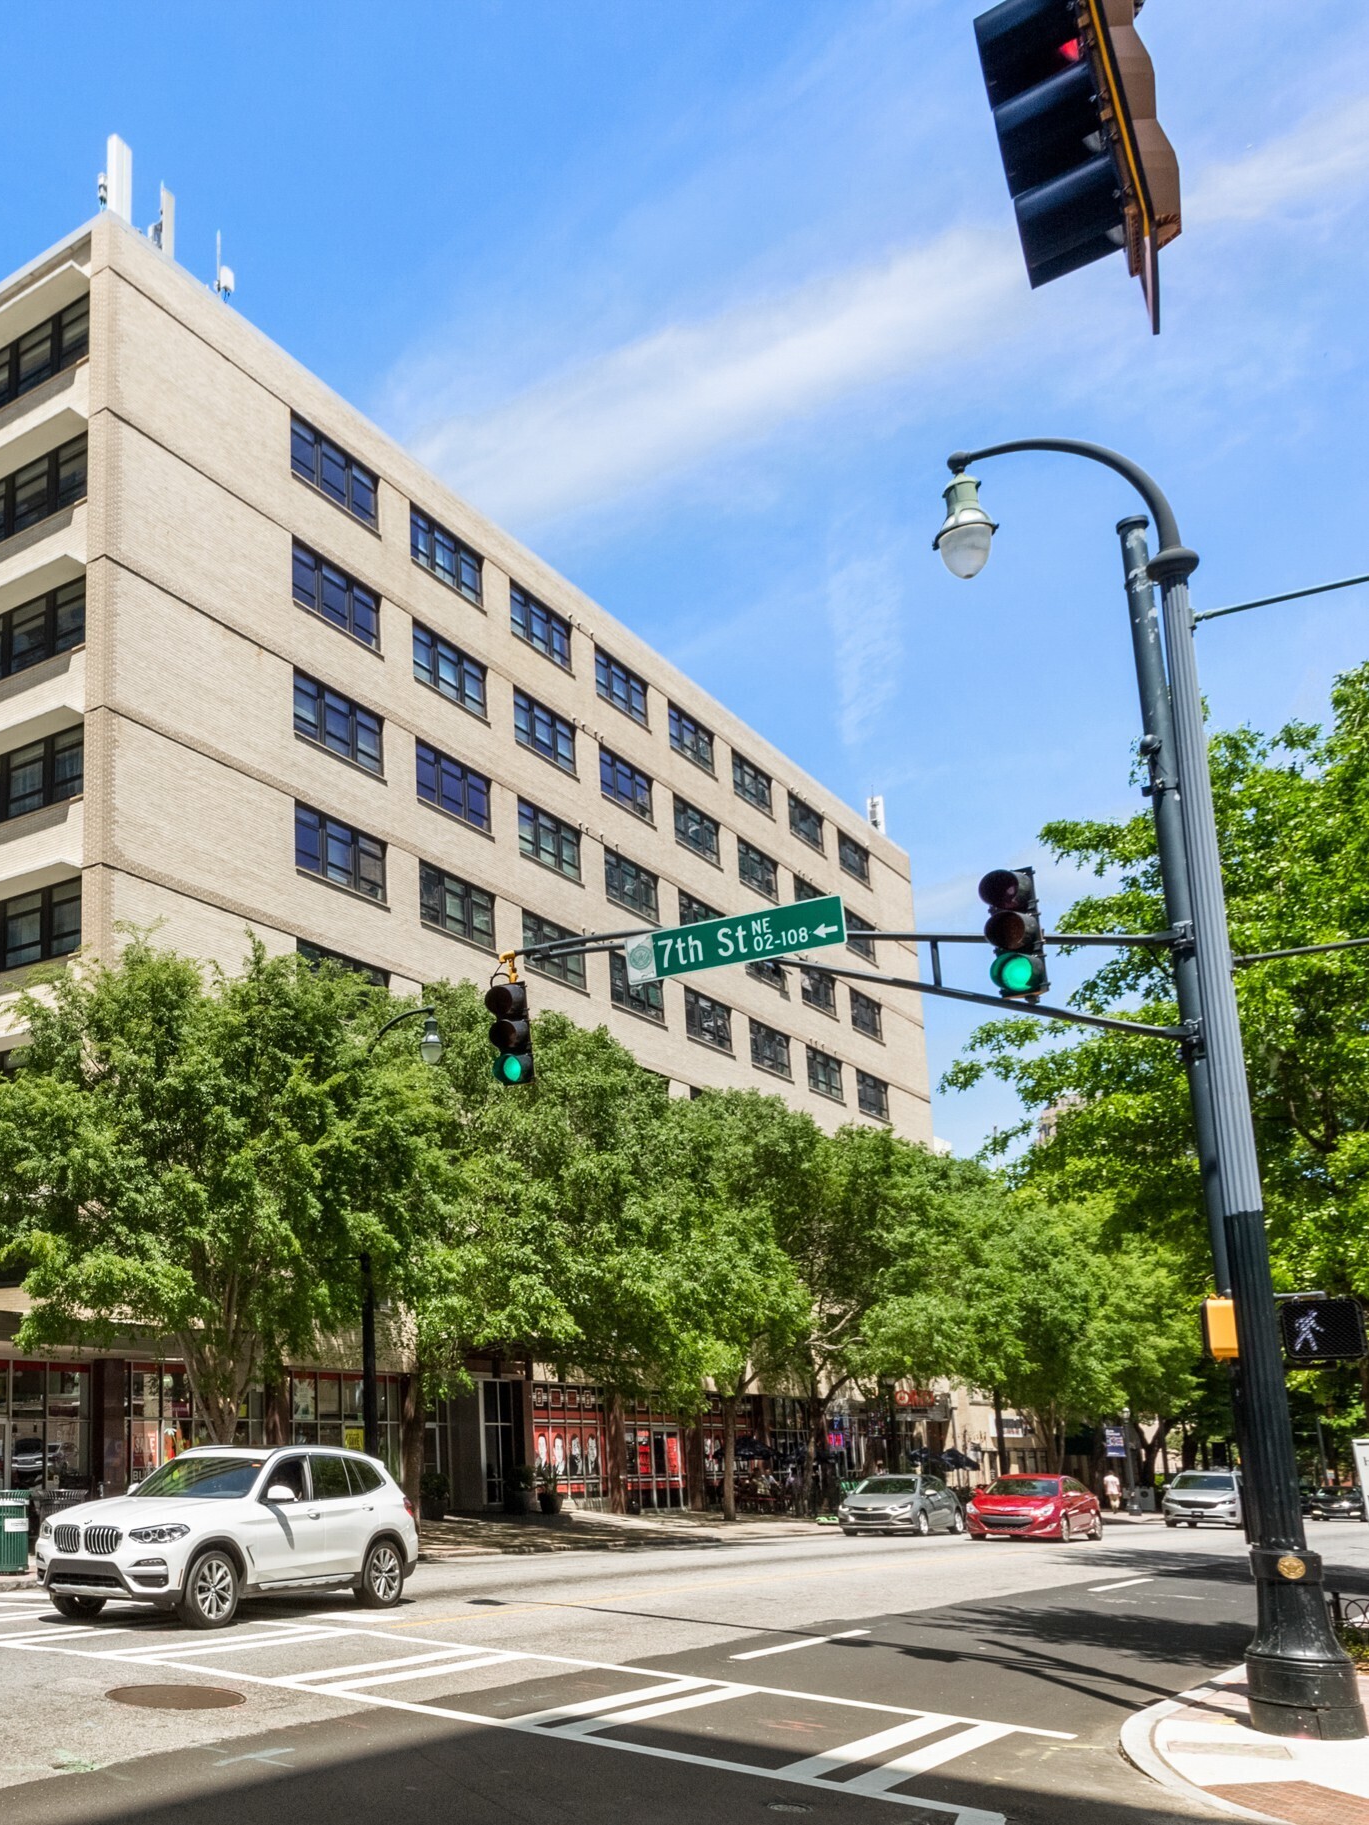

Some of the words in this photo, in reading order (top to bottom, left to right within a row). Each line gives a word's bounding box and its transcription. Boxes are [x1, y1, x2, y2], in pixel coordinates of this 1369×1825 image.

[657, 934, 704, 968] 7th
[717, 925, 748, 957] St
[751, 917, 772, 936] NE
[753, 926, 809, 952] 02-108
